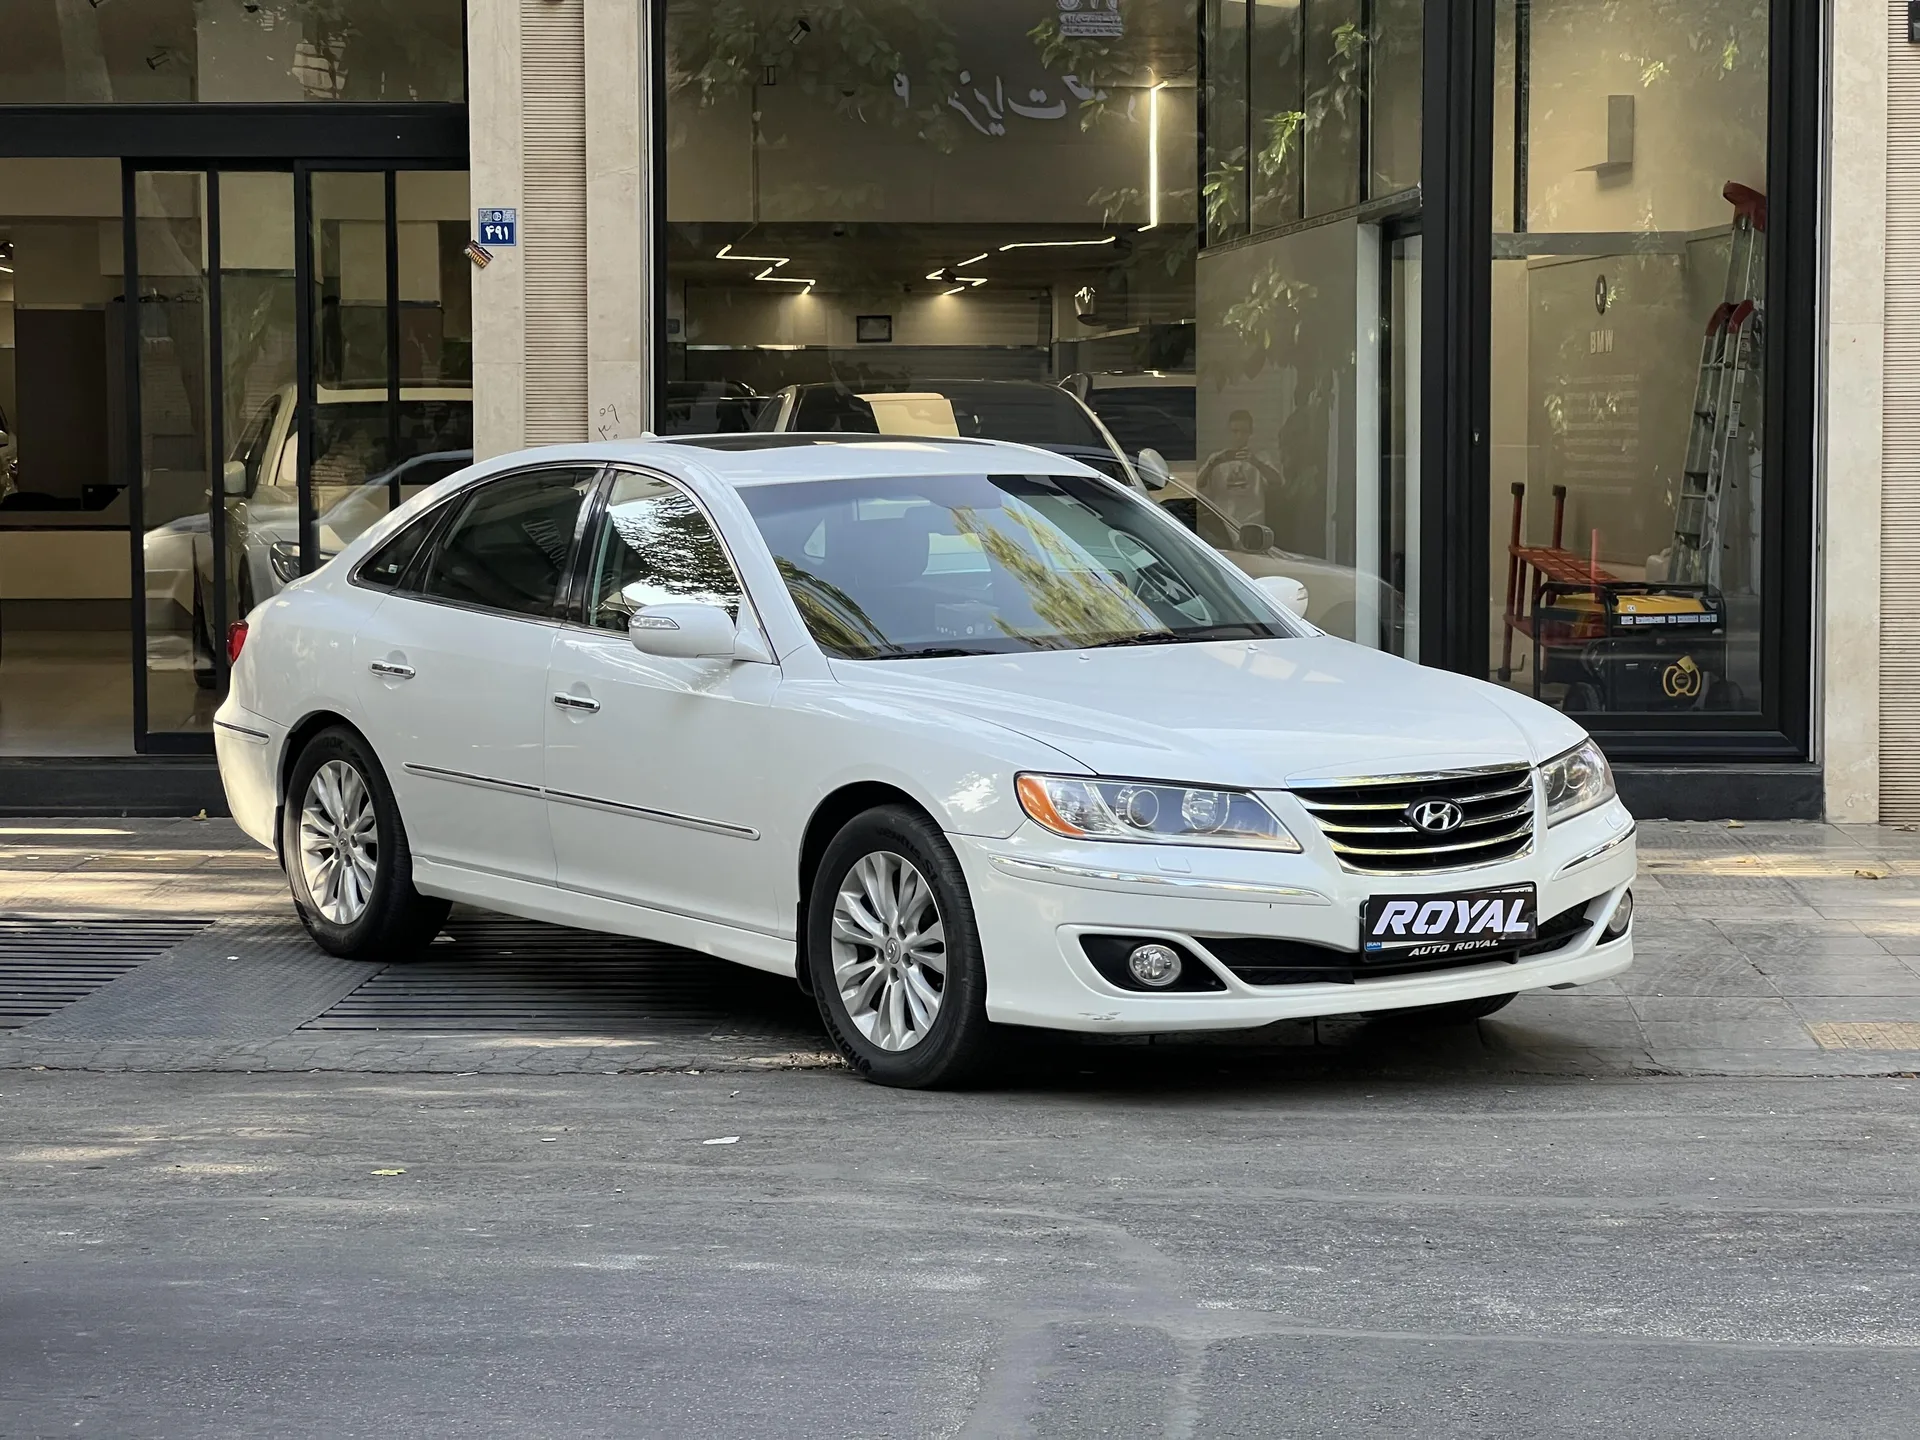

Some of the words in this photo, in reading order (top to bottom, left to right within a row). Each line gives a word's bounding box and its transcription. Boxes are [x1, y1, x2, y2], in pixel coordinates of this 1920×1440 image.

[485, 225, 509, 241] ۴۹۱
[1590, 329, 1613, 354] BMW
[1372, 899, 1530, 935] ROYAL
[1408, 943, 1450, 957] AUTO
[1454, 939, 1499, 951] ROYAL
